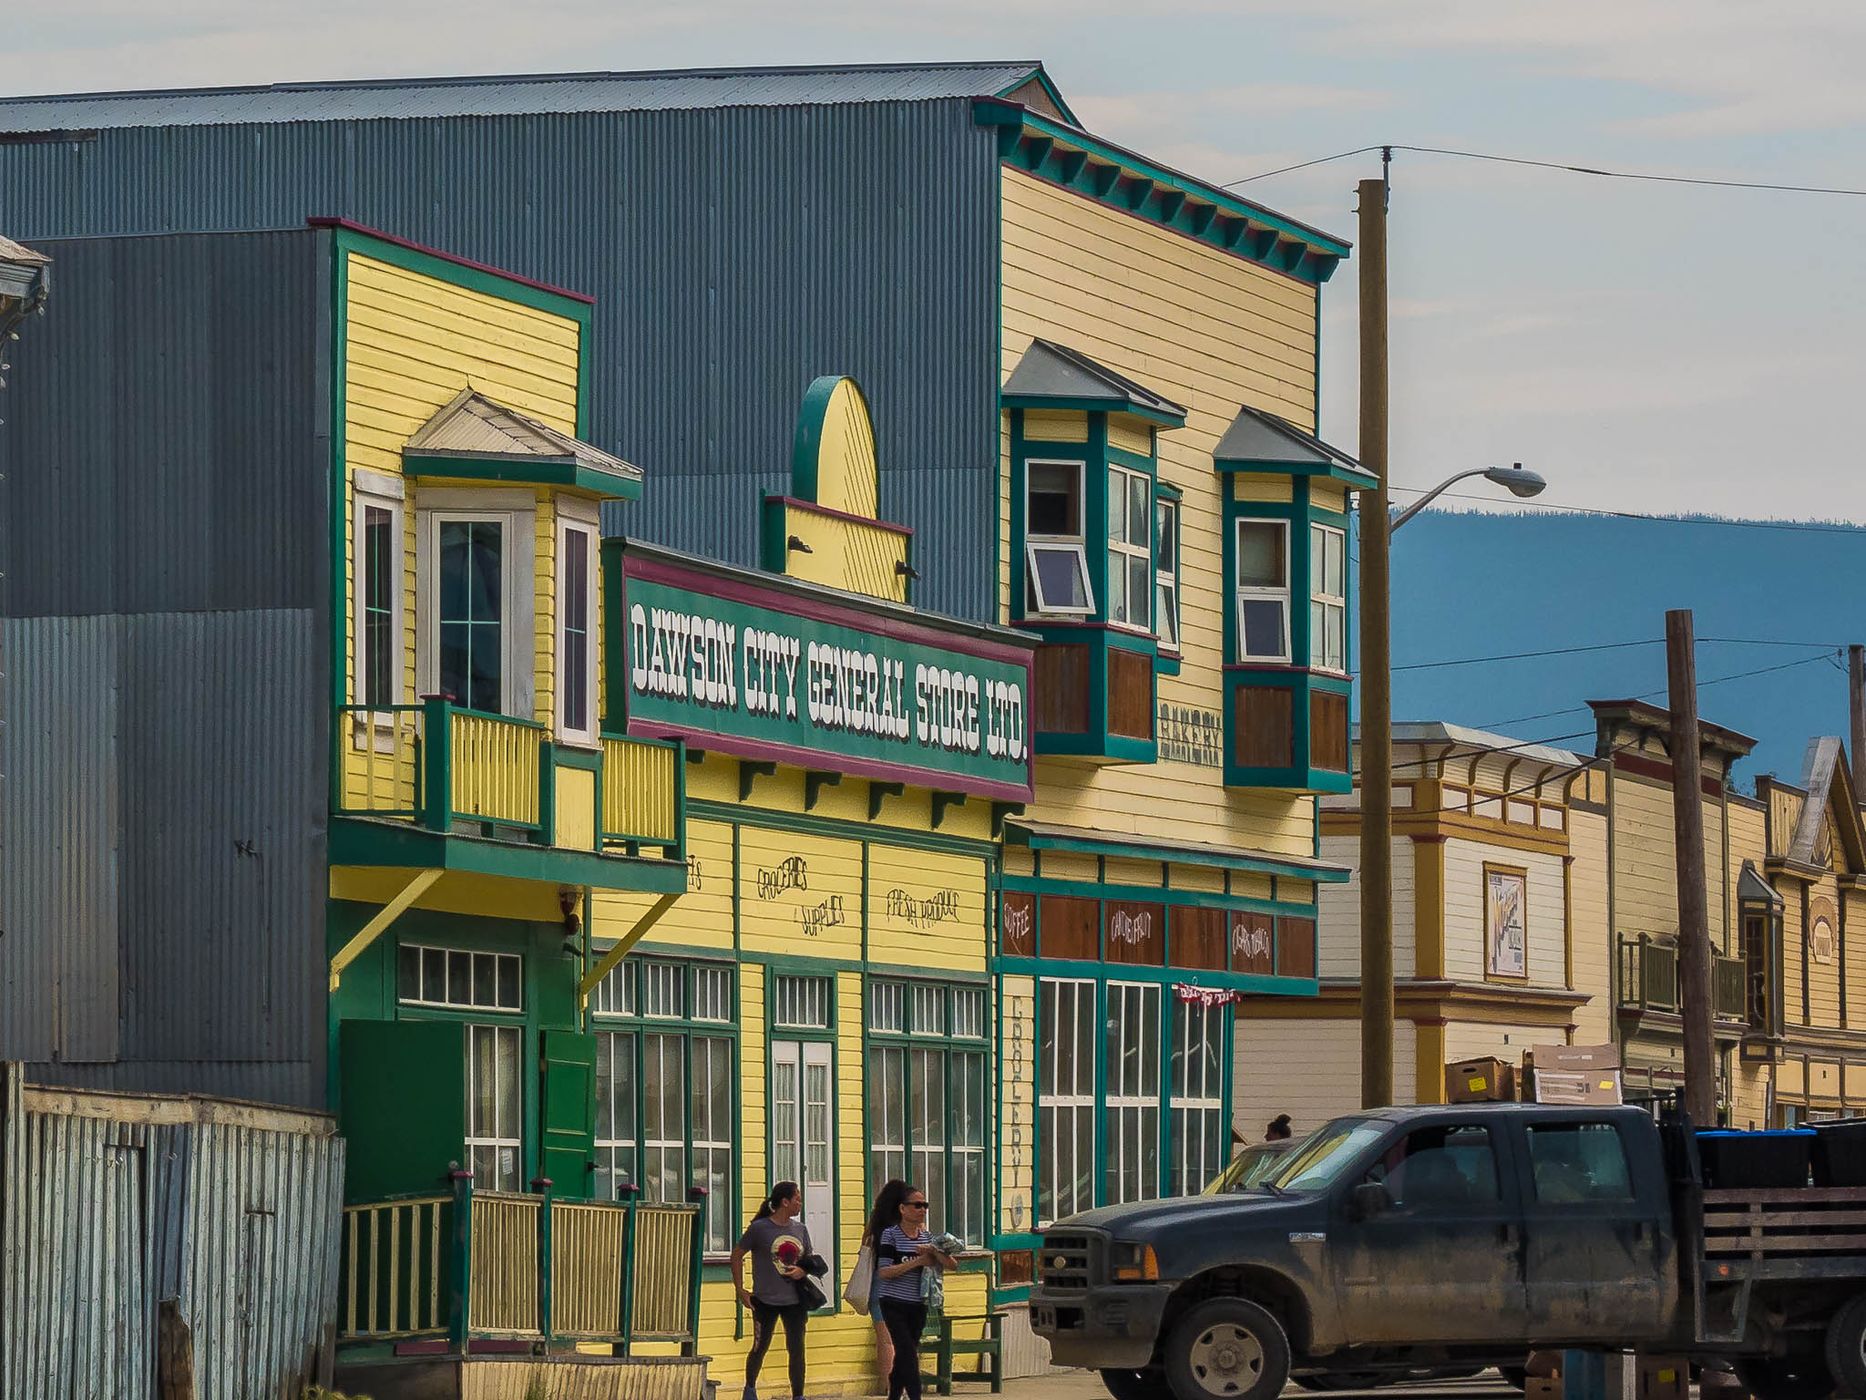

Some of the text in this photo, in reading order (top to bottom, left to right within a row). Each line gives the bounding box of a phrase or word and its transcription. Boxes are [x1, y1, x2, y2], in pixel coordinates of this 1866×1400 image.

[630, 603, 1028, 762] DAWSON CITY GENERAL STORE LTD.
[757, 856, 807, 899] GROCERIES
[801, 895, 845, 936] SUPPLIES
[886, 888, 960, 928] FRESH PRODUCE
